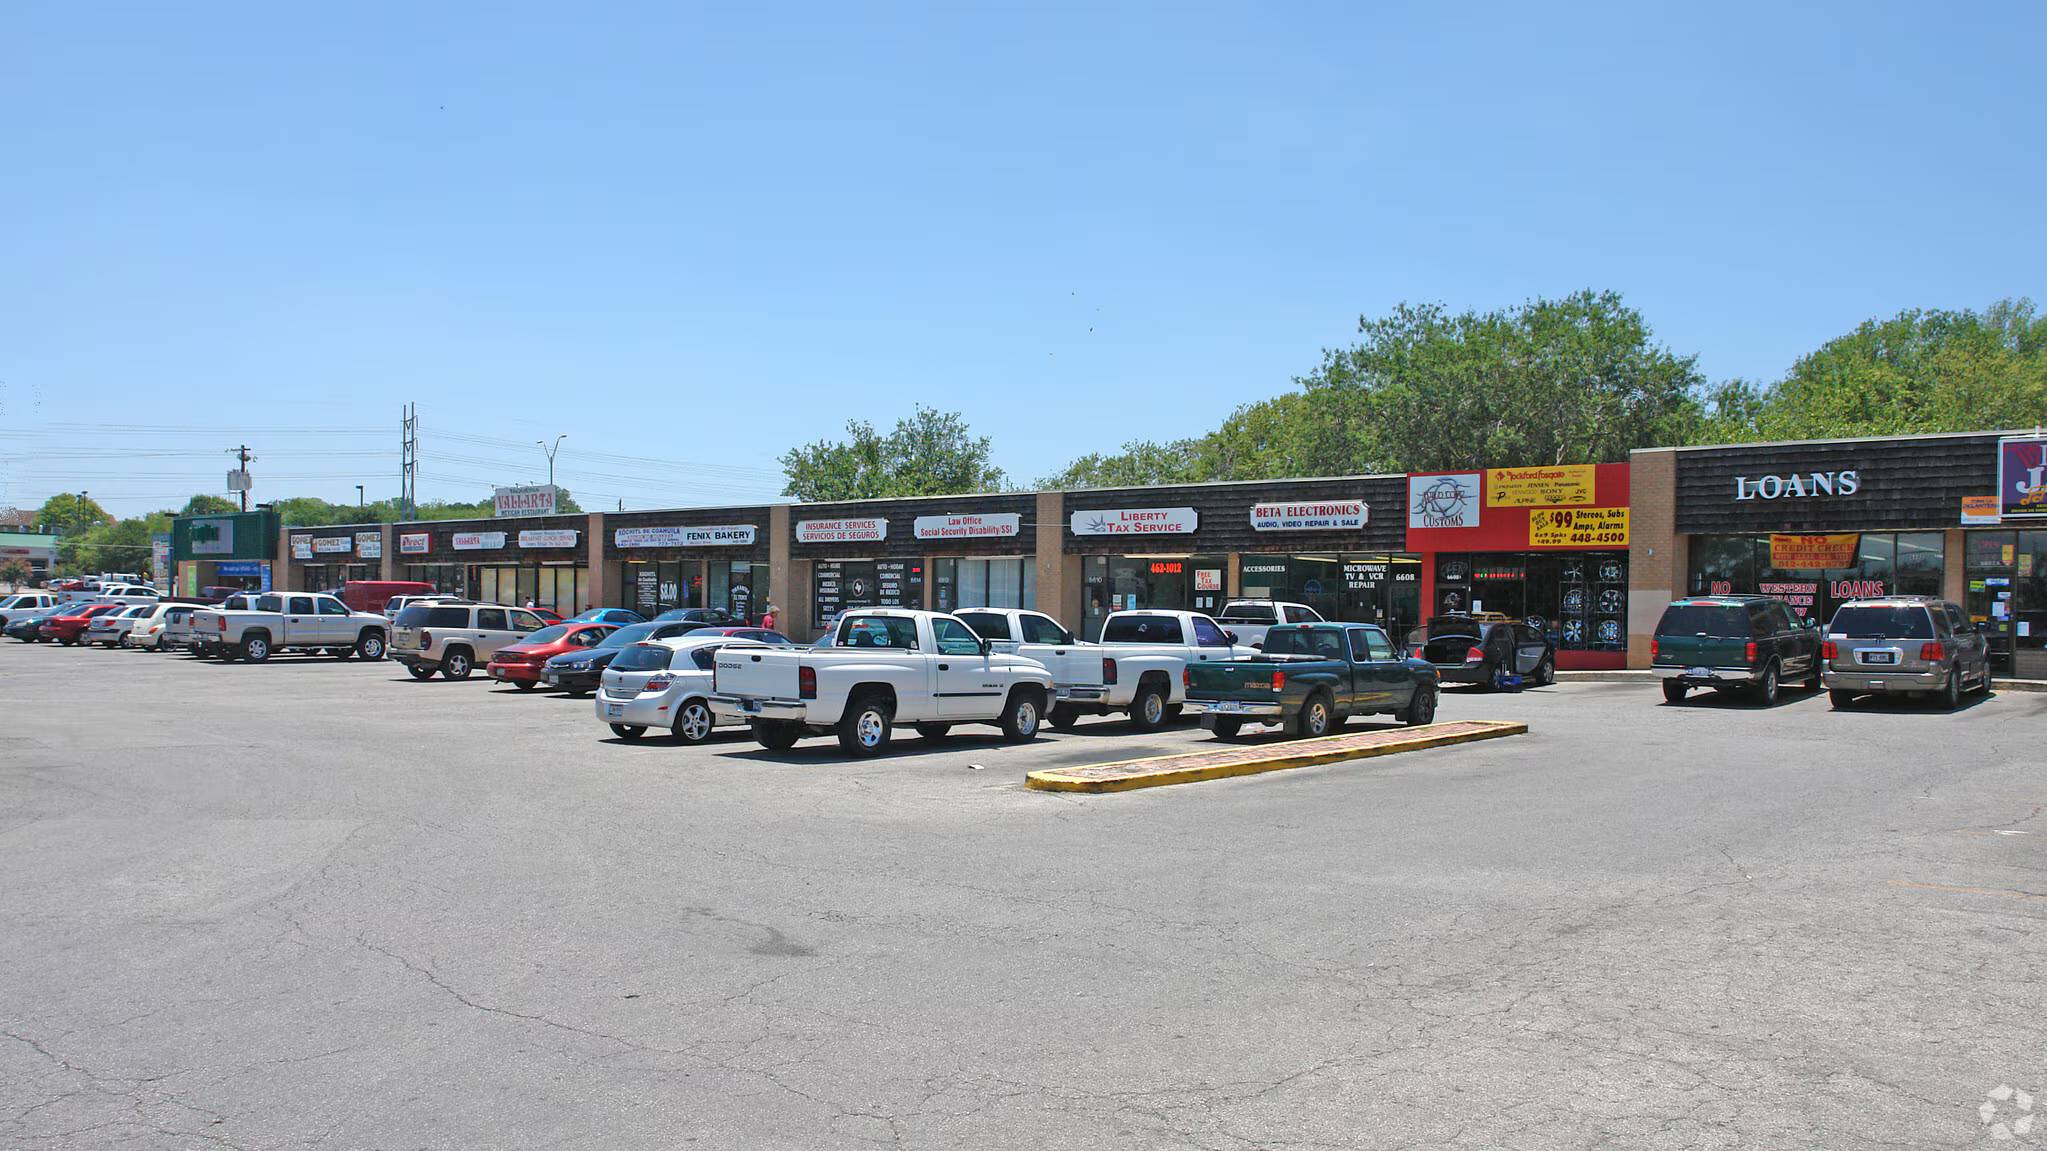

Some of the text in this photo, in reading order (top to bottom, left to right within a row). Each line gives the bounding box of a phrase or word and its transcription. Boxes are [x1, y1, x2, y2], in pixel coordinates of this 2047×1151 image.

[1735, 470, 1858, 500] LOANS
[497, 493, 553, 510] VALLARTA
[1255, 503, 1360, 517] BETA ELECTRONICS
[948, 516, 982, 526] Law Office
[1120, 511, 1168, 521] LIBERTY
[1423, 512, 1464, 527] CUSTOMS
[1549, 511, 1573, 528] $99
[1607, 509, 1624, 518] Subs
[805, 520, 876, 530] INSURANCE SERVICES
[1107, 522, 1182, 533] TAX SERVICE
[1257, 521, 1279, 529] AUDIO,
[1282, 520, 1302, 528] VIDEO
[1597, 521, 1624, 530] Alarms
[687, 532, 711, 540] FENIX
[715, 530, 751, 539] BAKERY
[803, 530, 879, 541] SERVICIOS DE SEGUROS
[920, 524, 1013, 537] Social Security Disability SSI
[1570, 532, 1625, 543] 448-4500
[1800, 536, 1828, 544] NO
[1774, 544, 1815, 552] CREDIT
[1243, 565, 1286, 573] ACCESSORIES
[1343, 564, 1387, 573] MICROWAVE
[1369, 572, 1384, 580] VCR
[1349, 581, 1376, 589] REPAIR
[1711, 581, 1732, 595] NO
[1758, 583, 1818, 594] WESTERN
[1830, 581, 1885, 598] LOANS
[718, 662, 742, 670] DODGE
